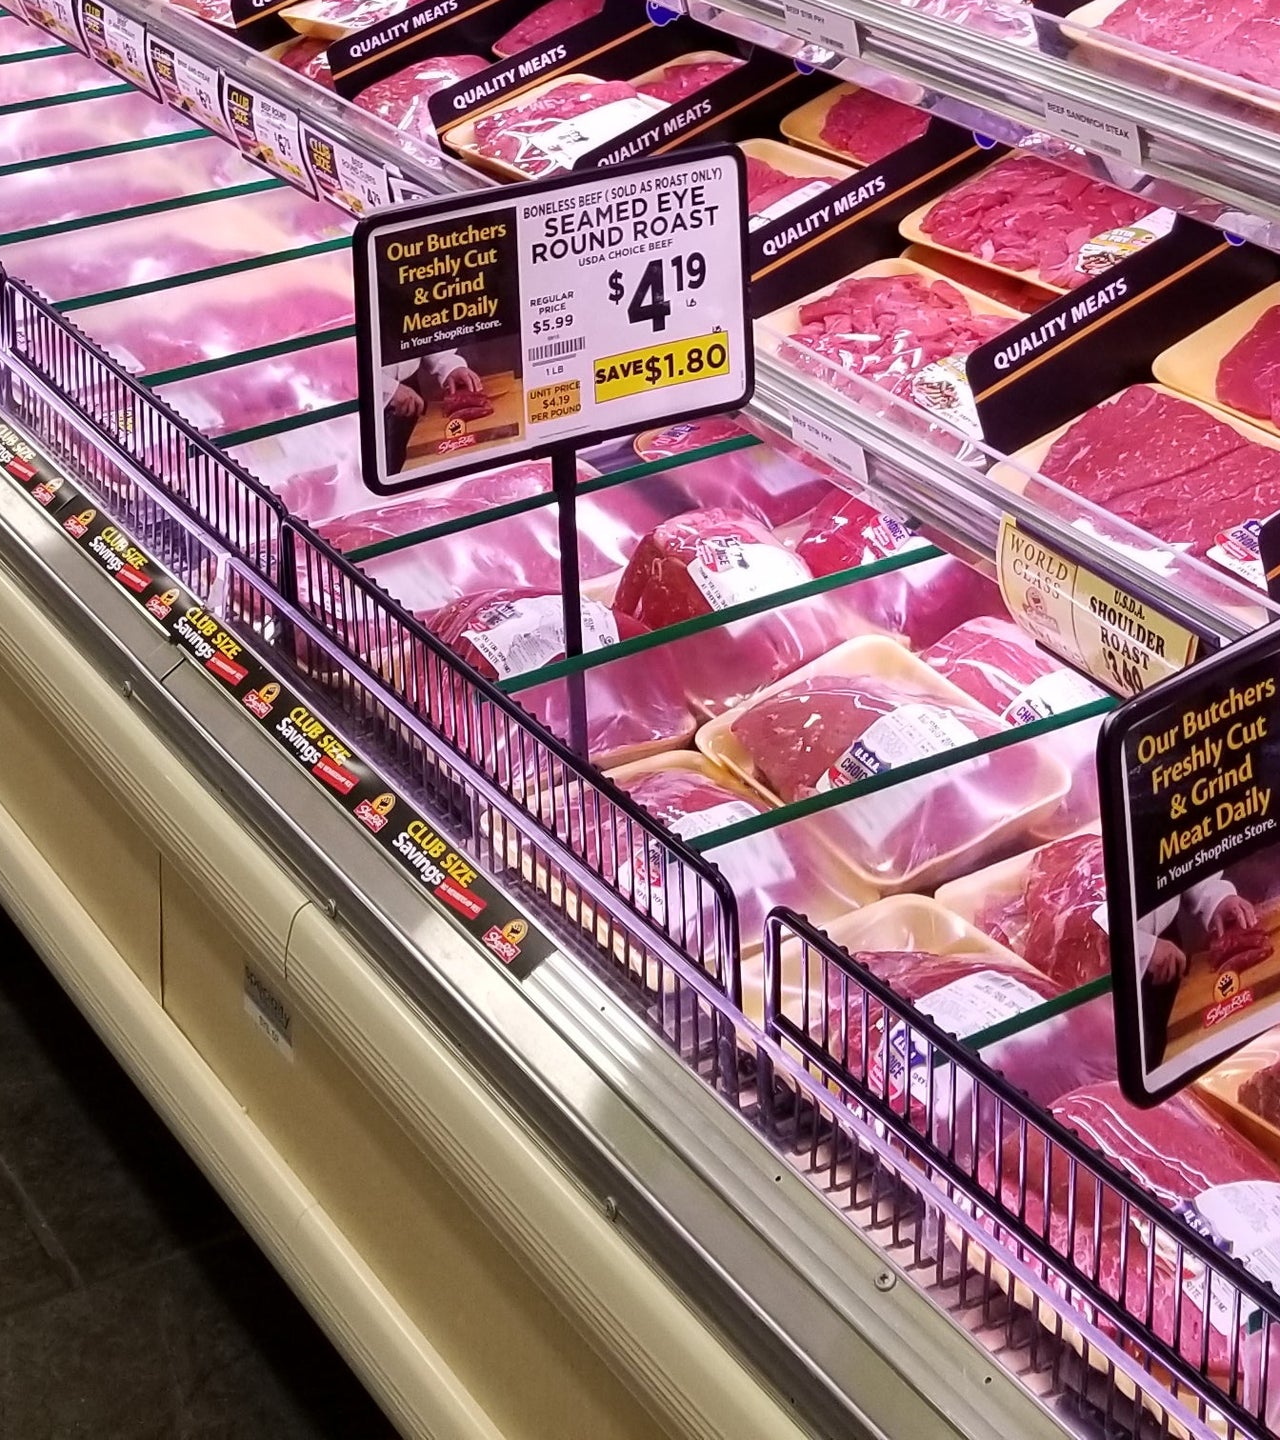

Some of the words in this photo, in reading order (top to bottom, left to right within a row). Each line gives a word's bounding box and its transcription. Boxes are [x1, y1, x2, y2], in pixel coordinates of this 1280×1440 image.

[532, 229, 624, 264] ROUND
[633, 206, 719, 242] ROAST
[545, 200, 648, 239] SEAMED
[658, 186, 705, 212] EYE
[579, 253, 606, 267] USDA
[607, 244, 646, 262] CHOICE
[649, 240, 673, 253] BEEF
[530, 291, 574, 307] REGULAR
[533, 314, 573, 335] $5.99
[538, 302, 566, 316] PRICE
[1010, 533, 1068, 581] WORLD
[1088, 596, 1165, 658] SHOULDER
[1100, 626, 1150, 671] ROAST
[1137, 725, 1178, 765] Our
[1182, 675, 1276, 743] Butchers
[1151, 737, 1224, 798] Freshly
[1226, 715, 1268, 758] Cut
[1170, 792, 1187, 819] &
[1191, 760, 1253, 808] Grind
[1159, 815, 1213, 865] Meat
[1216, 785, 1272, 840] Daily
[392, 832, 445, 885] Savings
[407, 820, 446, 858] CLUB
[440, 853, 478, 888] SIZE
[1156, 874, 1167, 890] in
[1169, 858, 1193, 883] Your
[1194, 835, 1243, 873] ShopRite
[1244, 817, 1278, 847] Store.
